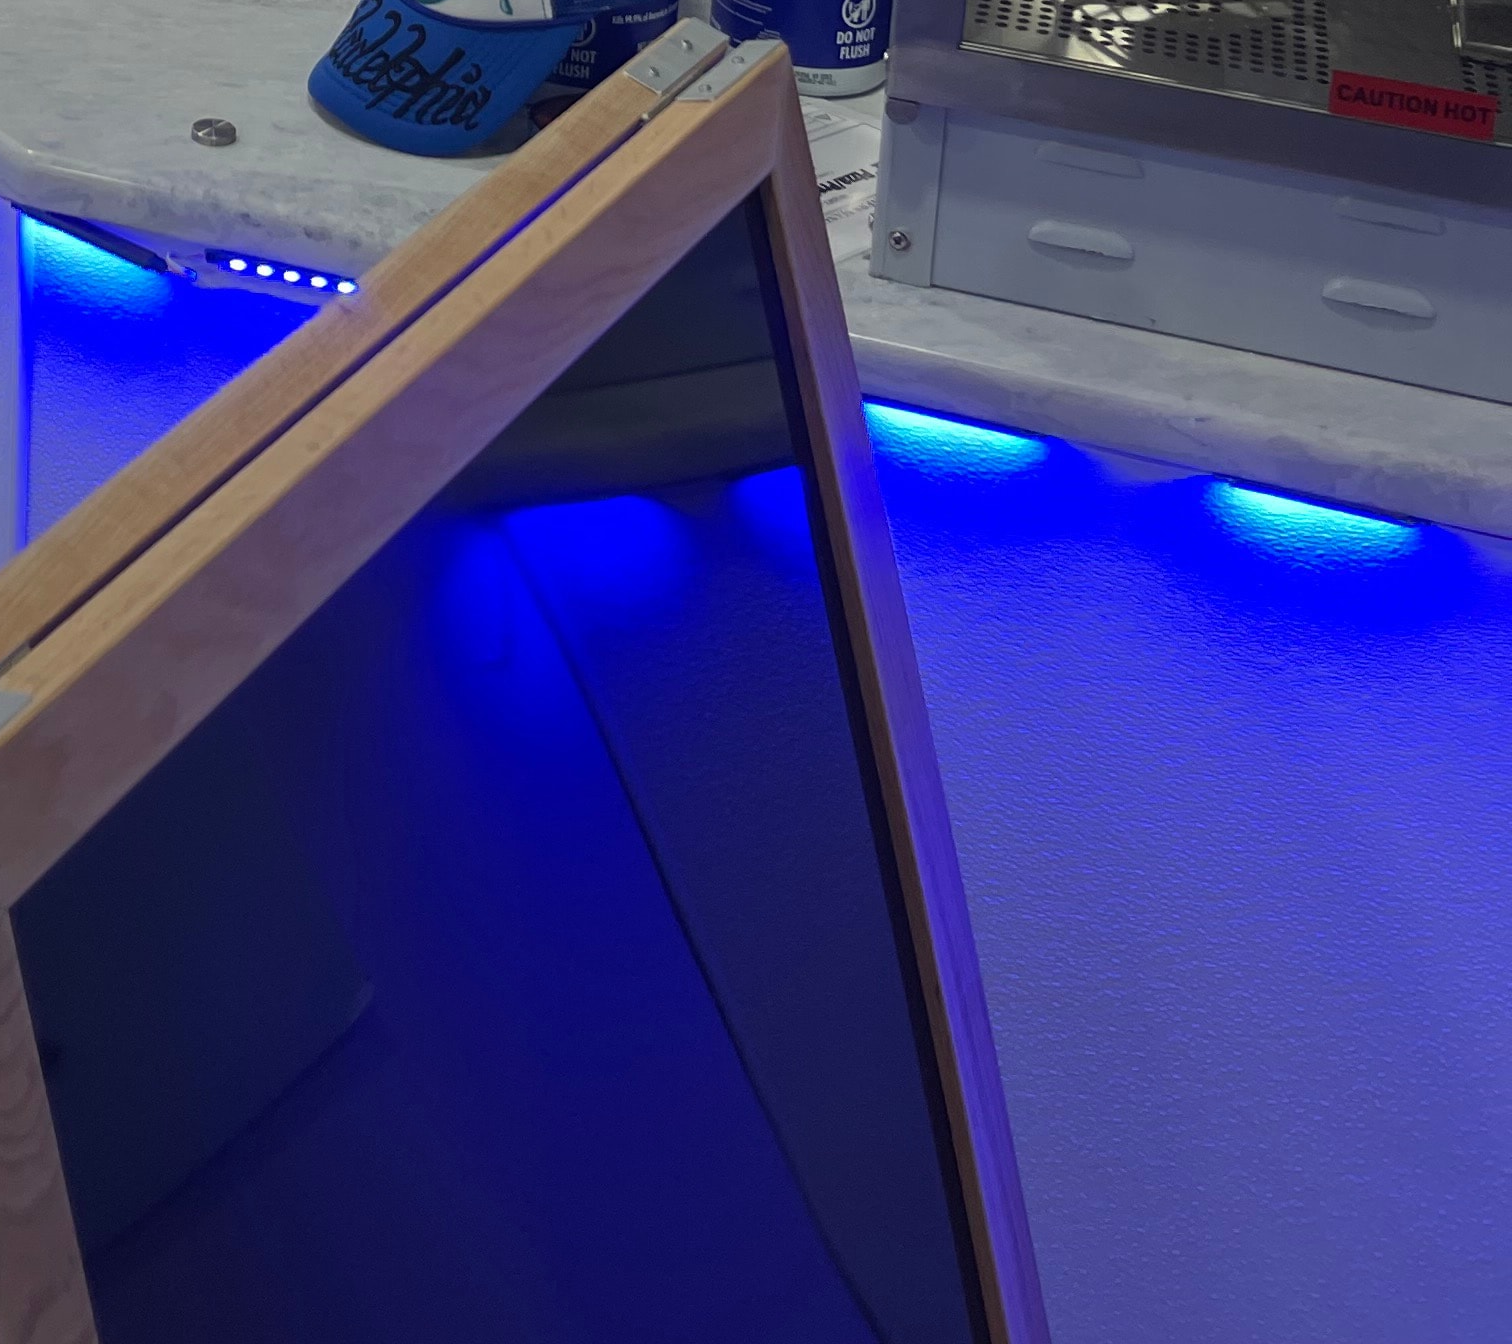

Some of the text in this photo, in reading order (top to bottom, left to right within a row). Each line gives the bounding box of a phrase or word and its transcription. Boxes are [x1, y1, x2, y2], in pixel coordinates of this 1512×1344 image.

[836, 26, 876, 45] DO NOT
[570, 48, 597, 64] NOT
[839, 42, 871, 60] FLUSH
[1337, 83, 1493, 125] CAUTION HOT
